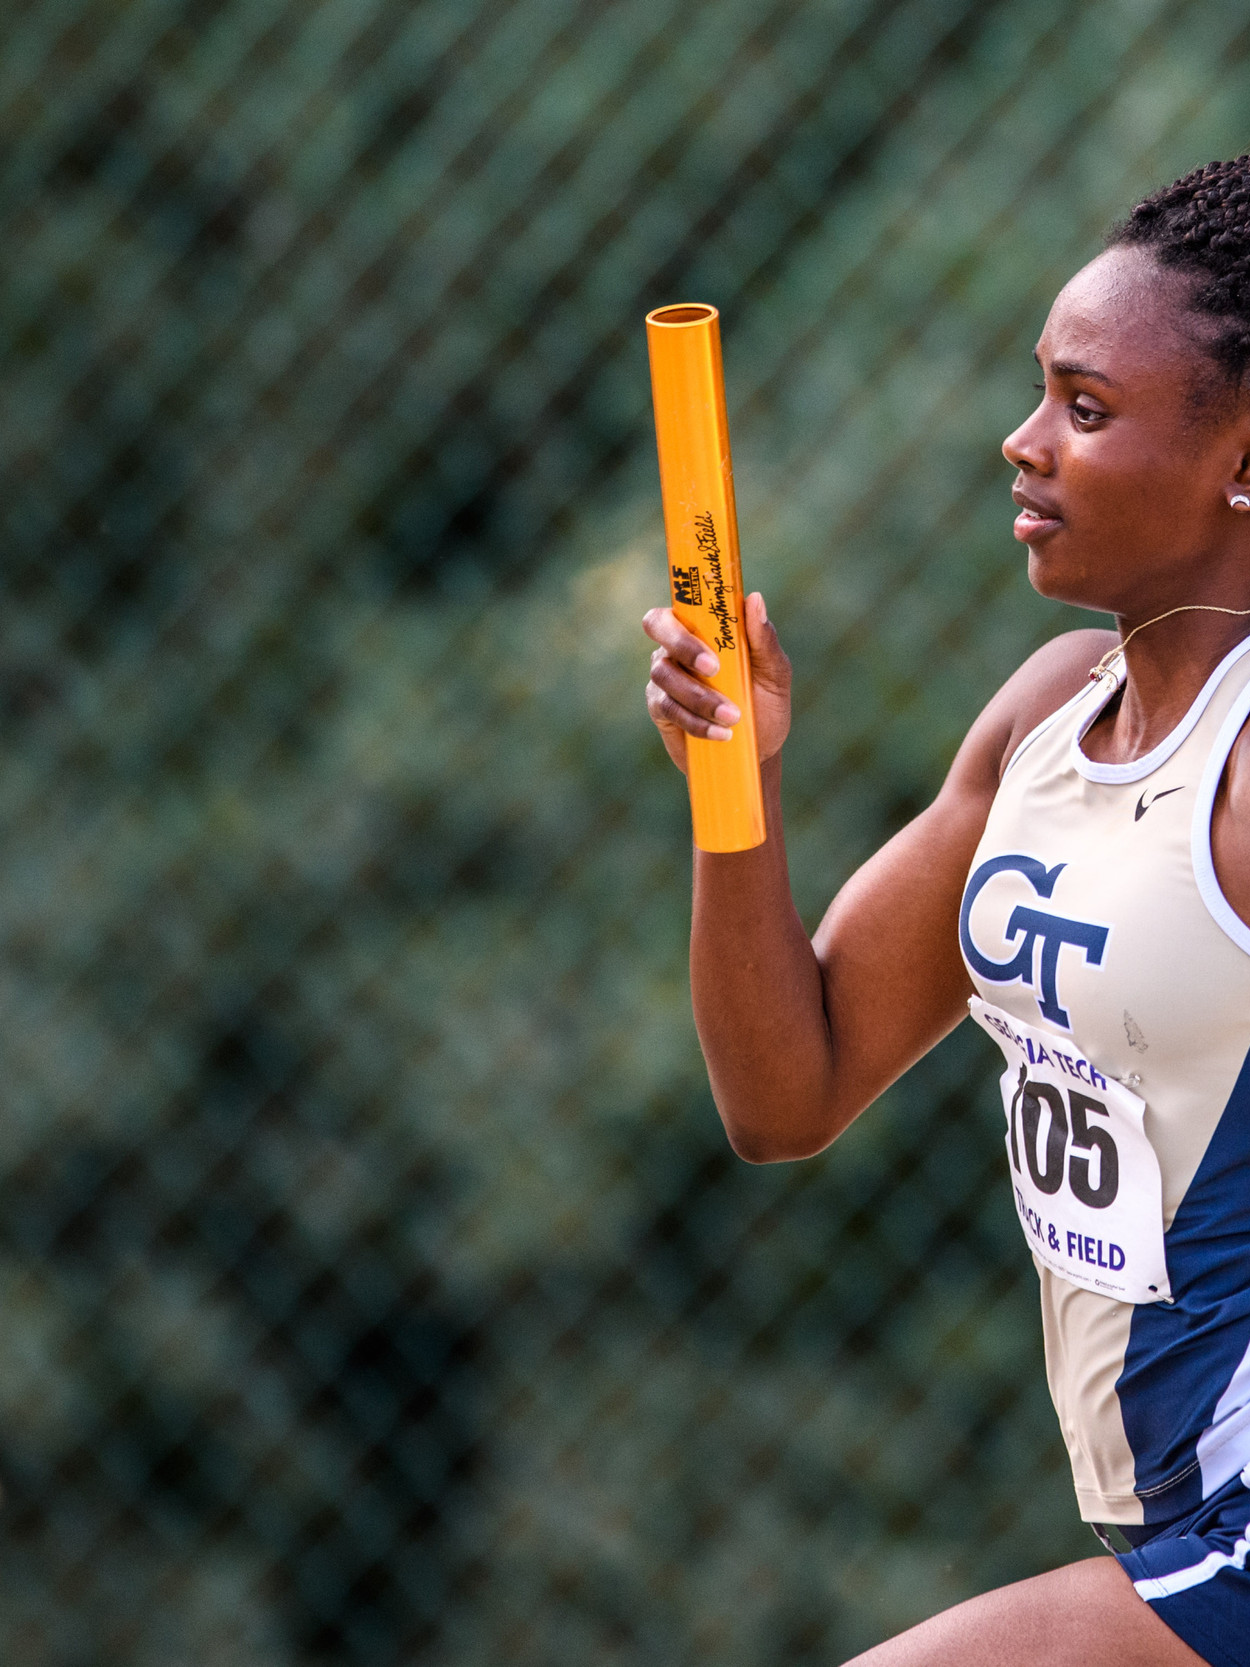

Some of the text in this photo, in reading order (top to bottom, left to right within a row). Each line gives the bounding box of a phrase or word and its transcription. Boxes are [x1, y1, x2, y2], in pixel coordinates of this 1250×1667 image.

[959, 852, 1111, 1030] GT
[984, 1013, 1107, 1091] GEIA TECH
[1015, 1185, 1045, 1242] TCK
[1047, 1223, 1060, 1252] &
[1066, 1230, 1126, 1271] FIELD
